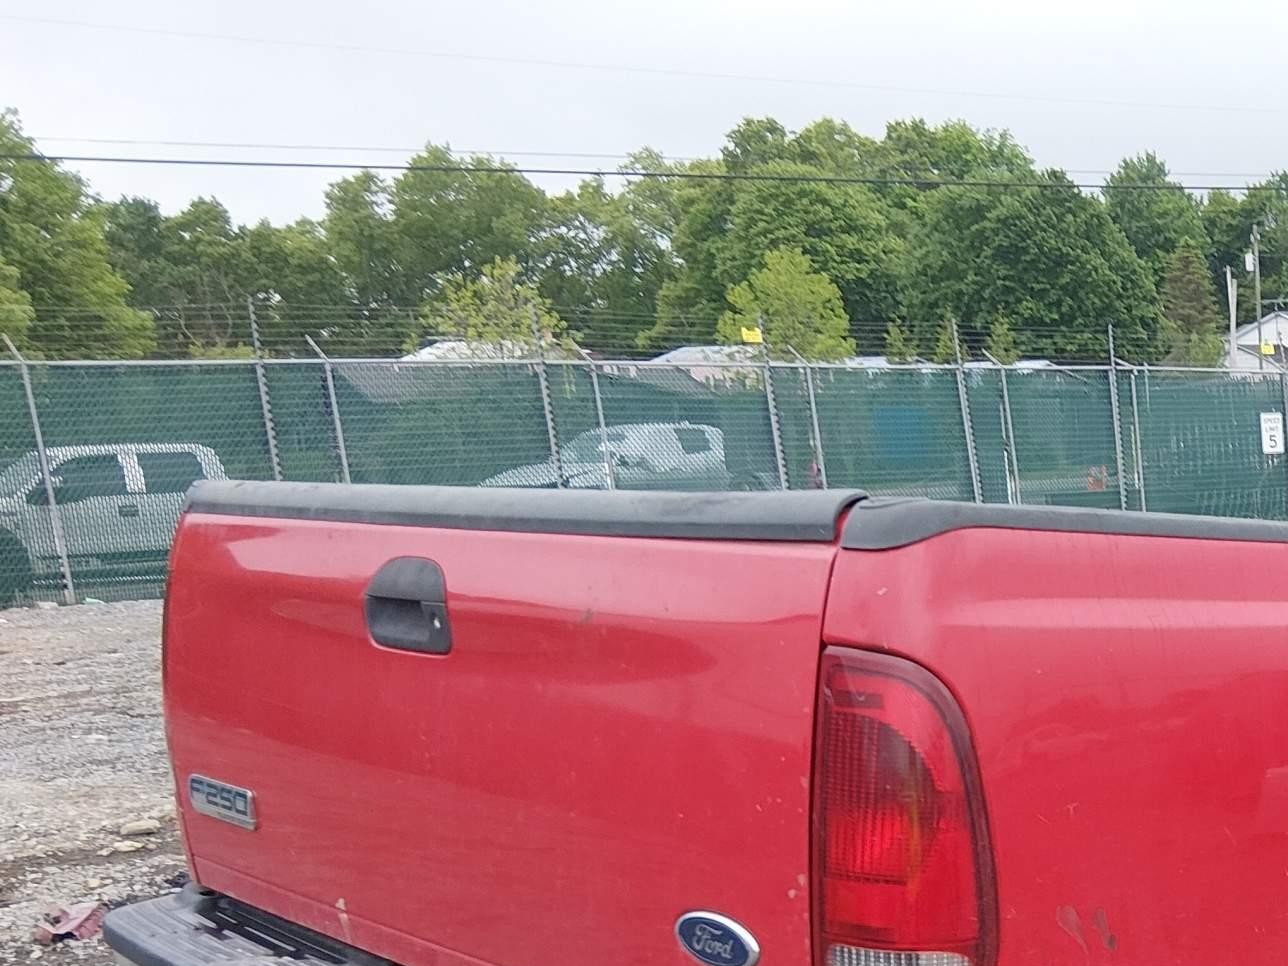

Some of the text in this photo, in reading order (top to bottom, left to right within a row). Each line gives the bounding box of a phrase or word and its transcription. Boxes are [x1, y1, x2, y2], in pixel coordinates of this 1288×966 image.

[1269, 434, 1278, 448] 5
[191, 778, 248, 817] F250
[692, 924, 735, 959] Ford
